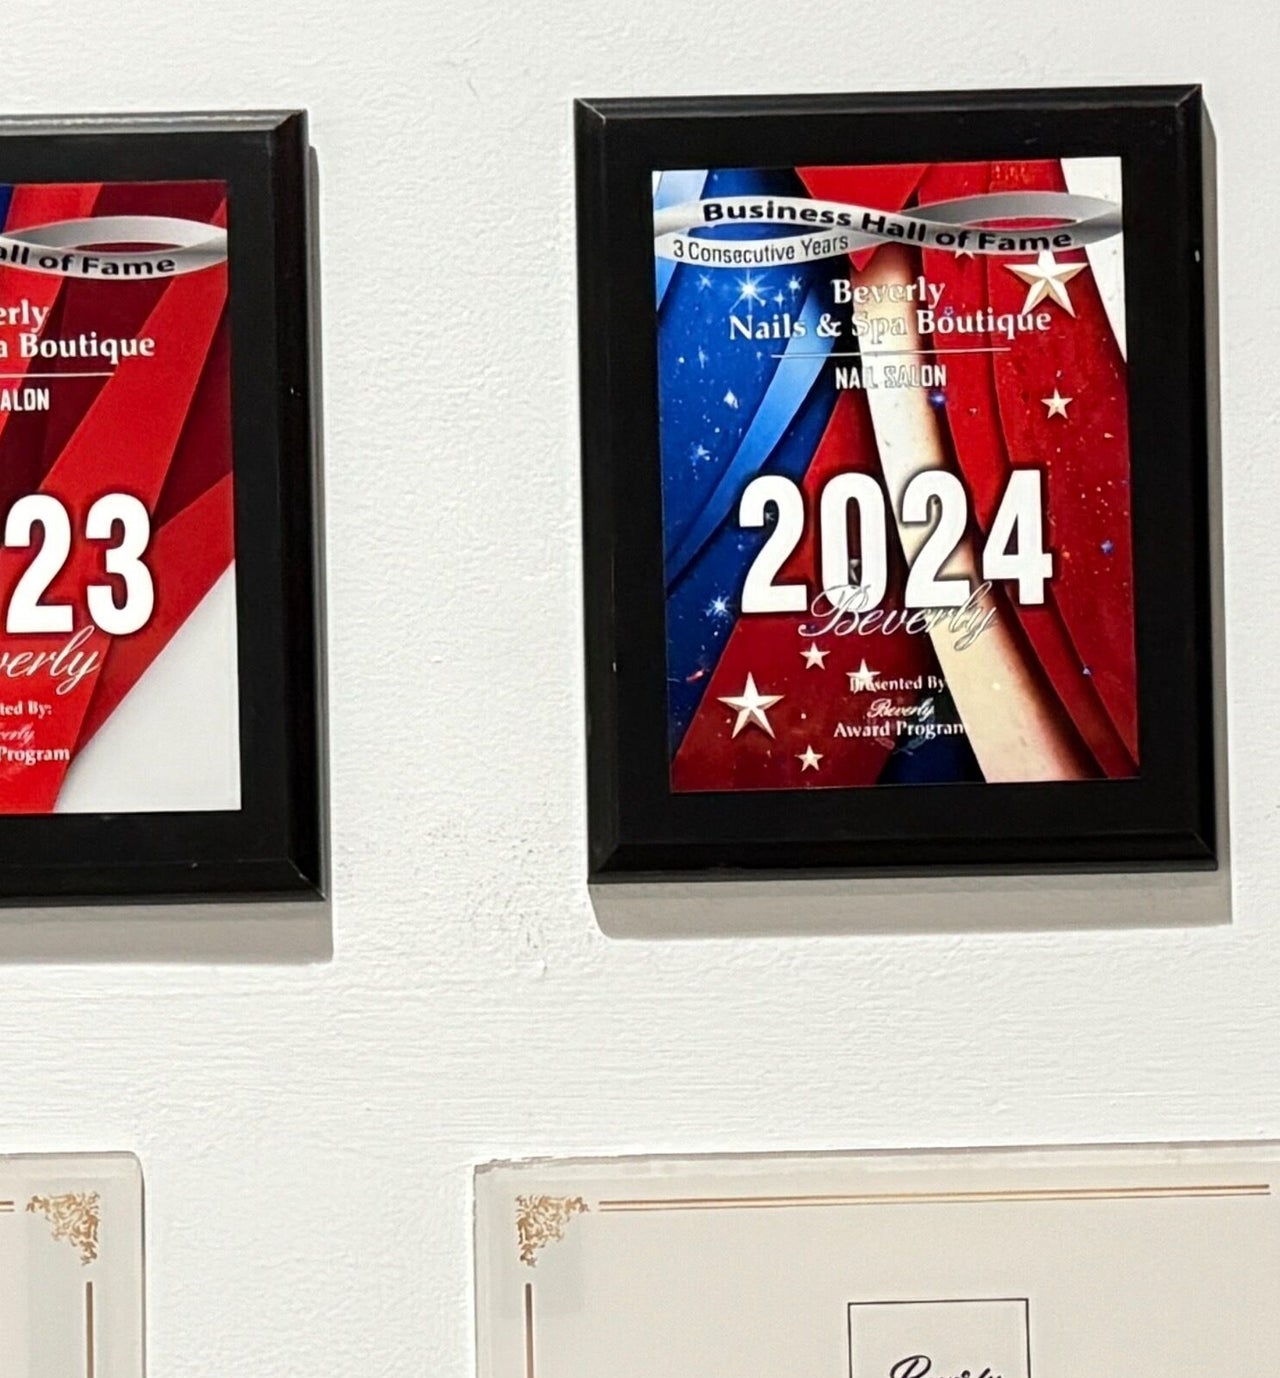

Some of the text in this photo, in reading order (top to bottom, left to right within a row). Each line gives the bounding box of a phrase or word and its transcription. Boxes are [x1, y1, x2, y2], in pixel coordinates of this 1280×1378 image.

[702, 200, 1072, 252] Business Hall of Fame
[39, 254, 72, 272] of
[82, 256, 176, 275] Fame
[673, 234, 848, 264] 3 Consecutive Years
[830, 276, 945, 309] Beverly
[729, 308, 1052, 345] Nails & Spa Boutique
[20, 331, 155, 364] Boutique
[835, 365, 947, 390] NAIL SALON
[738, 469, 1053, 615] 2024
[799, 581, 1001, 650] Beverly
[28, 700, 52, 719] By:
[833, 721, 890, 738] Award
